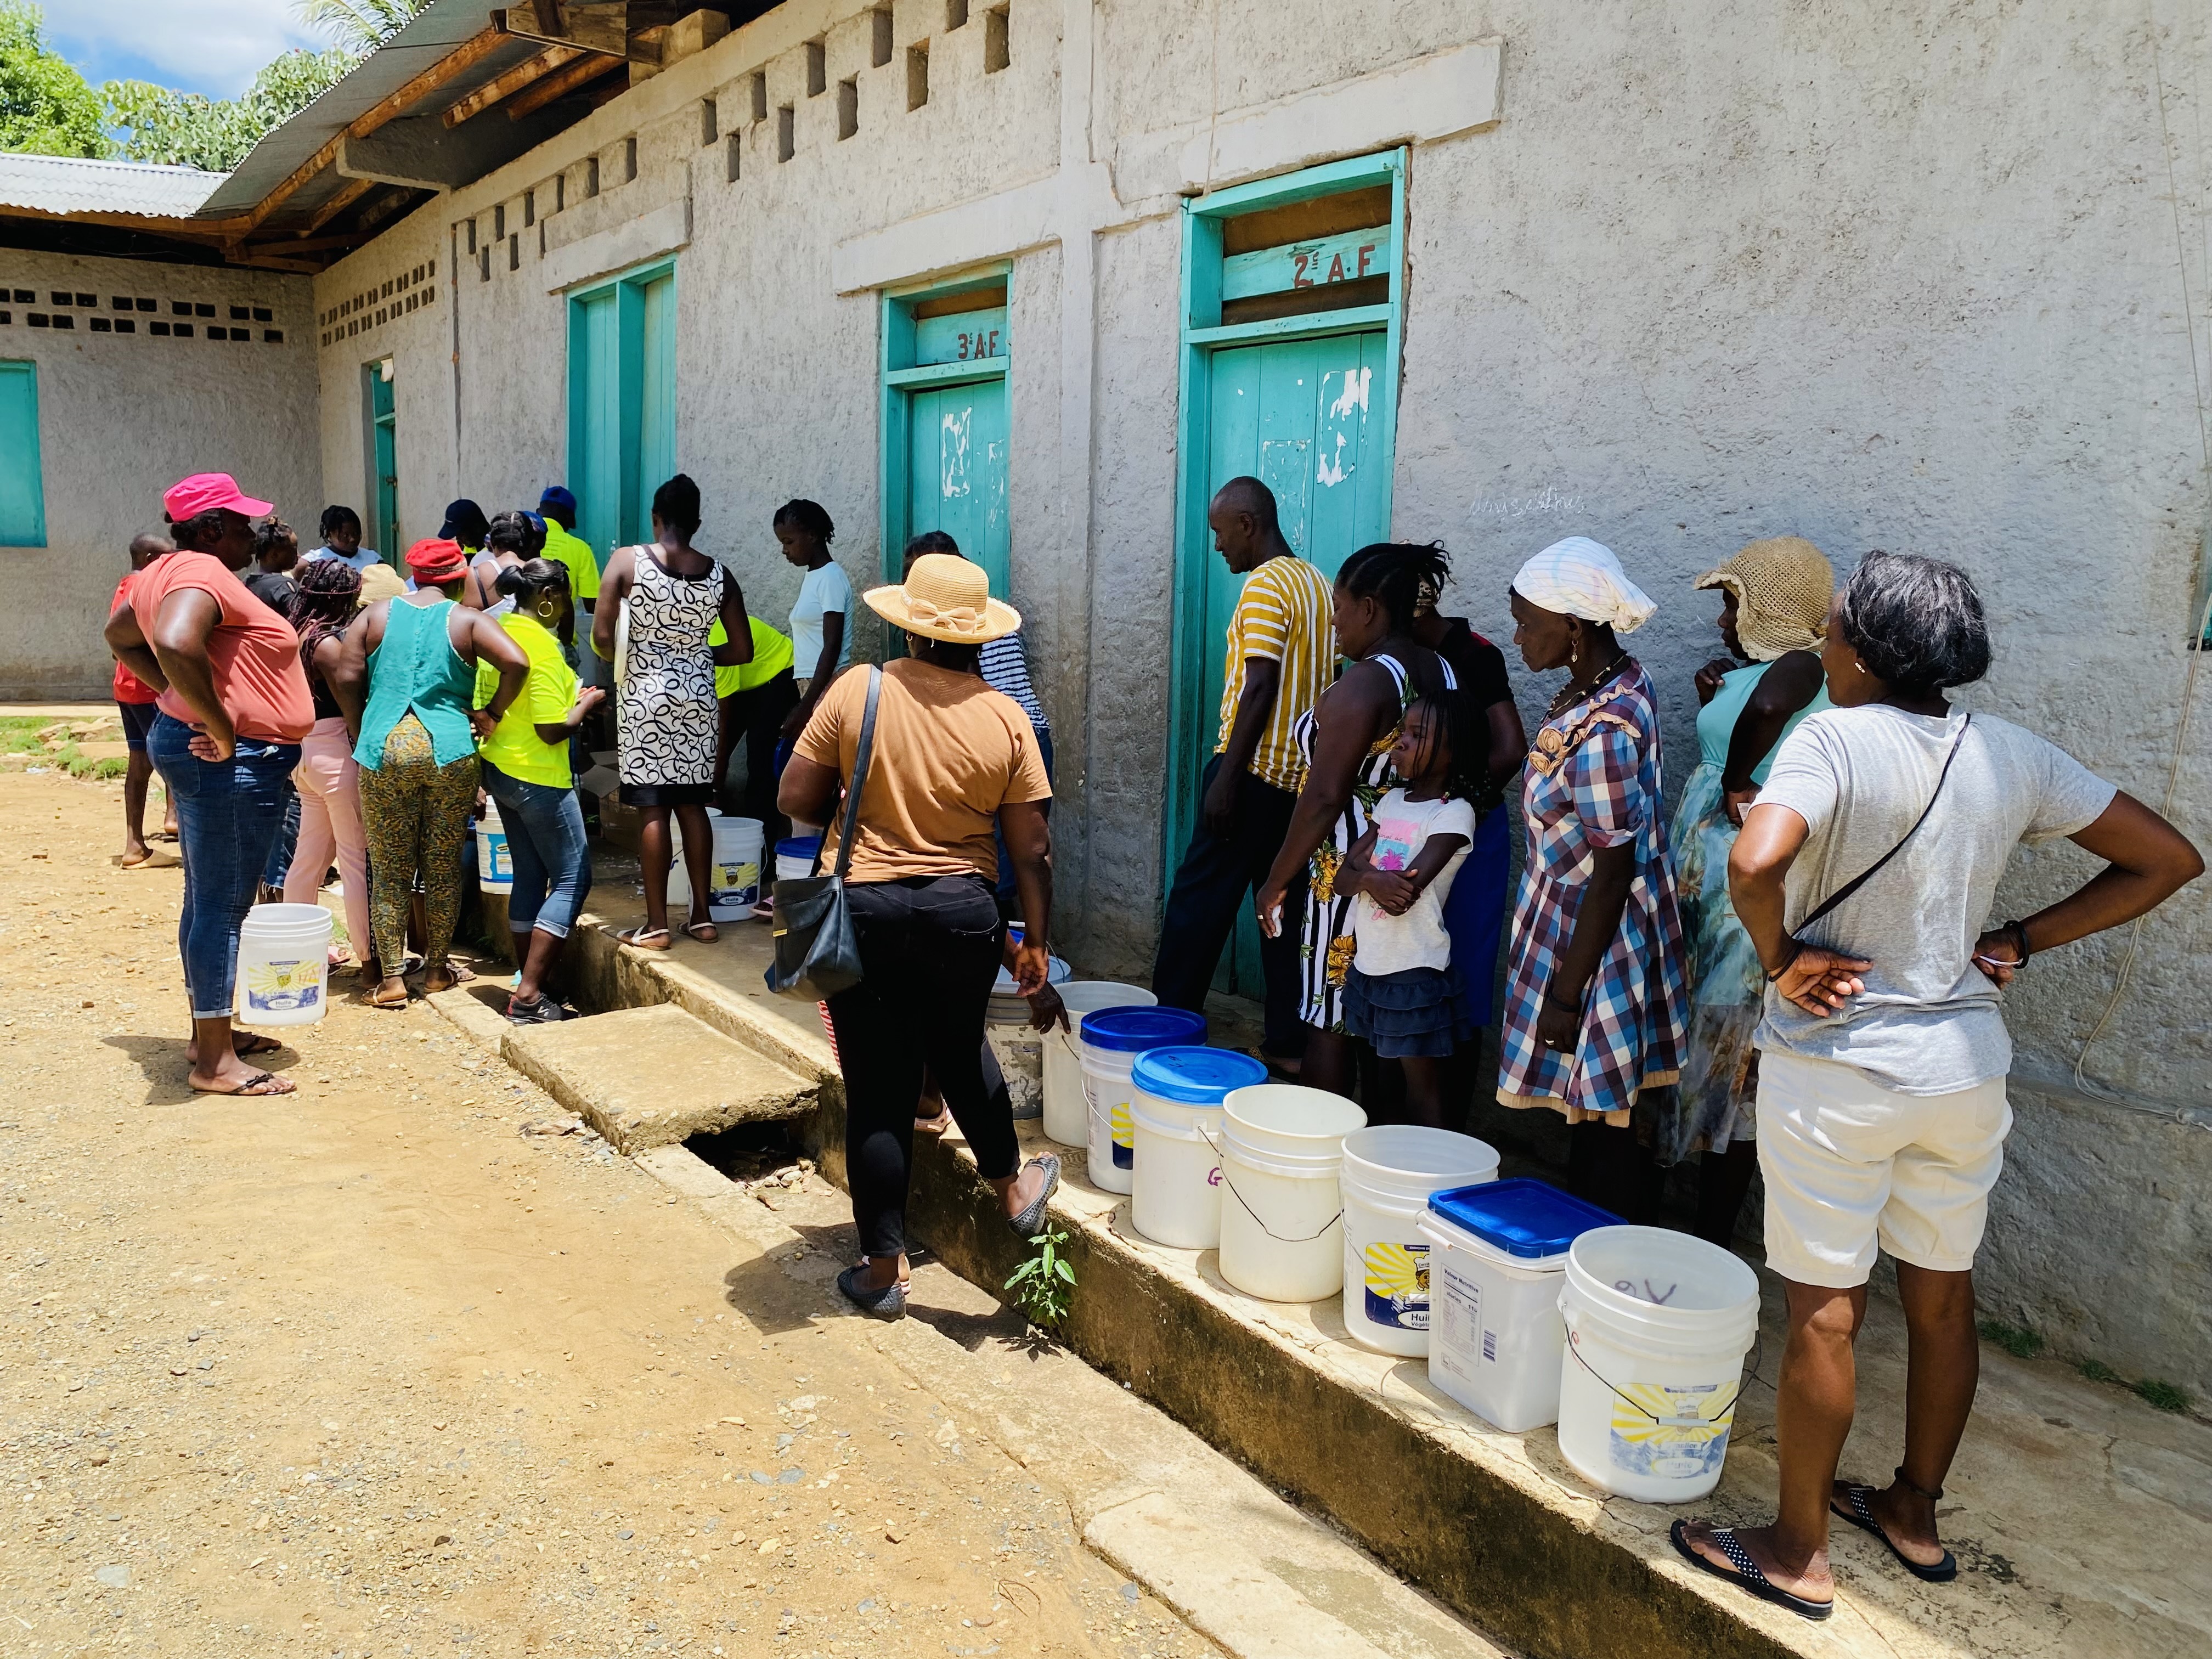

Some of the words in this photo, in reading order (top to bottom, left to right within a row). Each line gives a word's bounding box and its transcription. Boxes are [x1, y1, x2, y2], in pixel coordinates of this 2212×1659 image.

[1444, 1268, 1458, 1280] Valeur
[1459, 1278, 1479, 1293] Nutritive
[1446, 1290, 1462, 1304] alories
[1411, 1313, 1430, 1322] Huil
